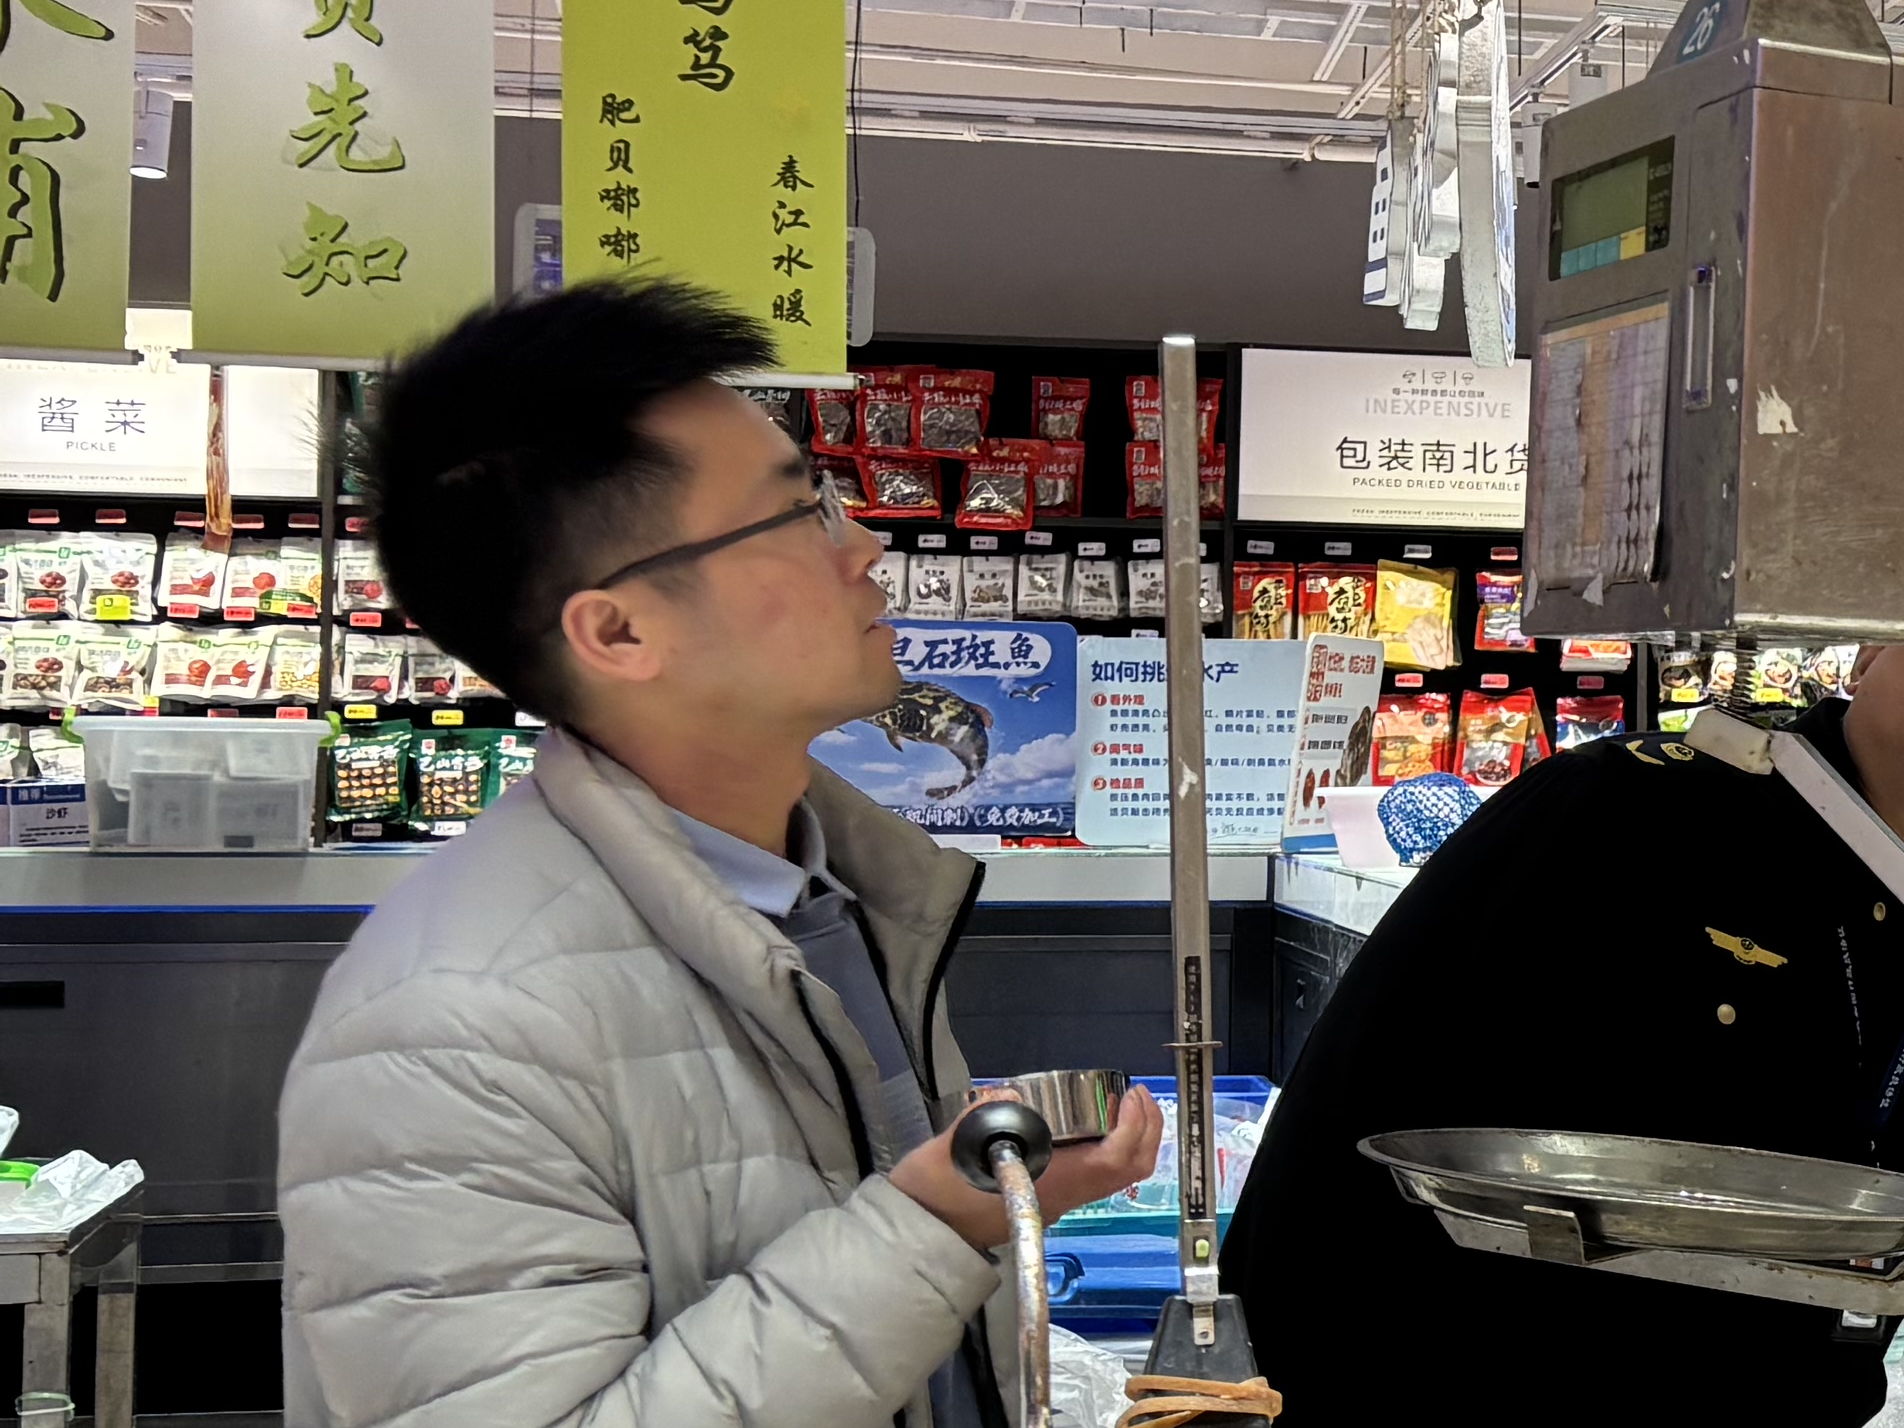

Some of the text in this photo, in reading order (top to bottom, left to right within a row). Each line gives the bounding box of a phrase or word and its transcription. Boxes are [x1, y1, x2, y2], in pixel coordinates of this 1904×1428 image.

[1683, 1, 1721, 56] 26
[598, 93, 641, 267] 肥贝嘟嘟
[770, 154, 815, 328] 春江水暖
[38, 396, 147, 435] 酱菜
[1365, 398, 1513, 419] INEXPENSIVE
[66, 441, 117, 452] PICKLE
[1335, 436, 1529, 476] 包装南北货
[1352, 477, 1402, 488] PACKED
[1407, 479, 1445, 489] DRIED
